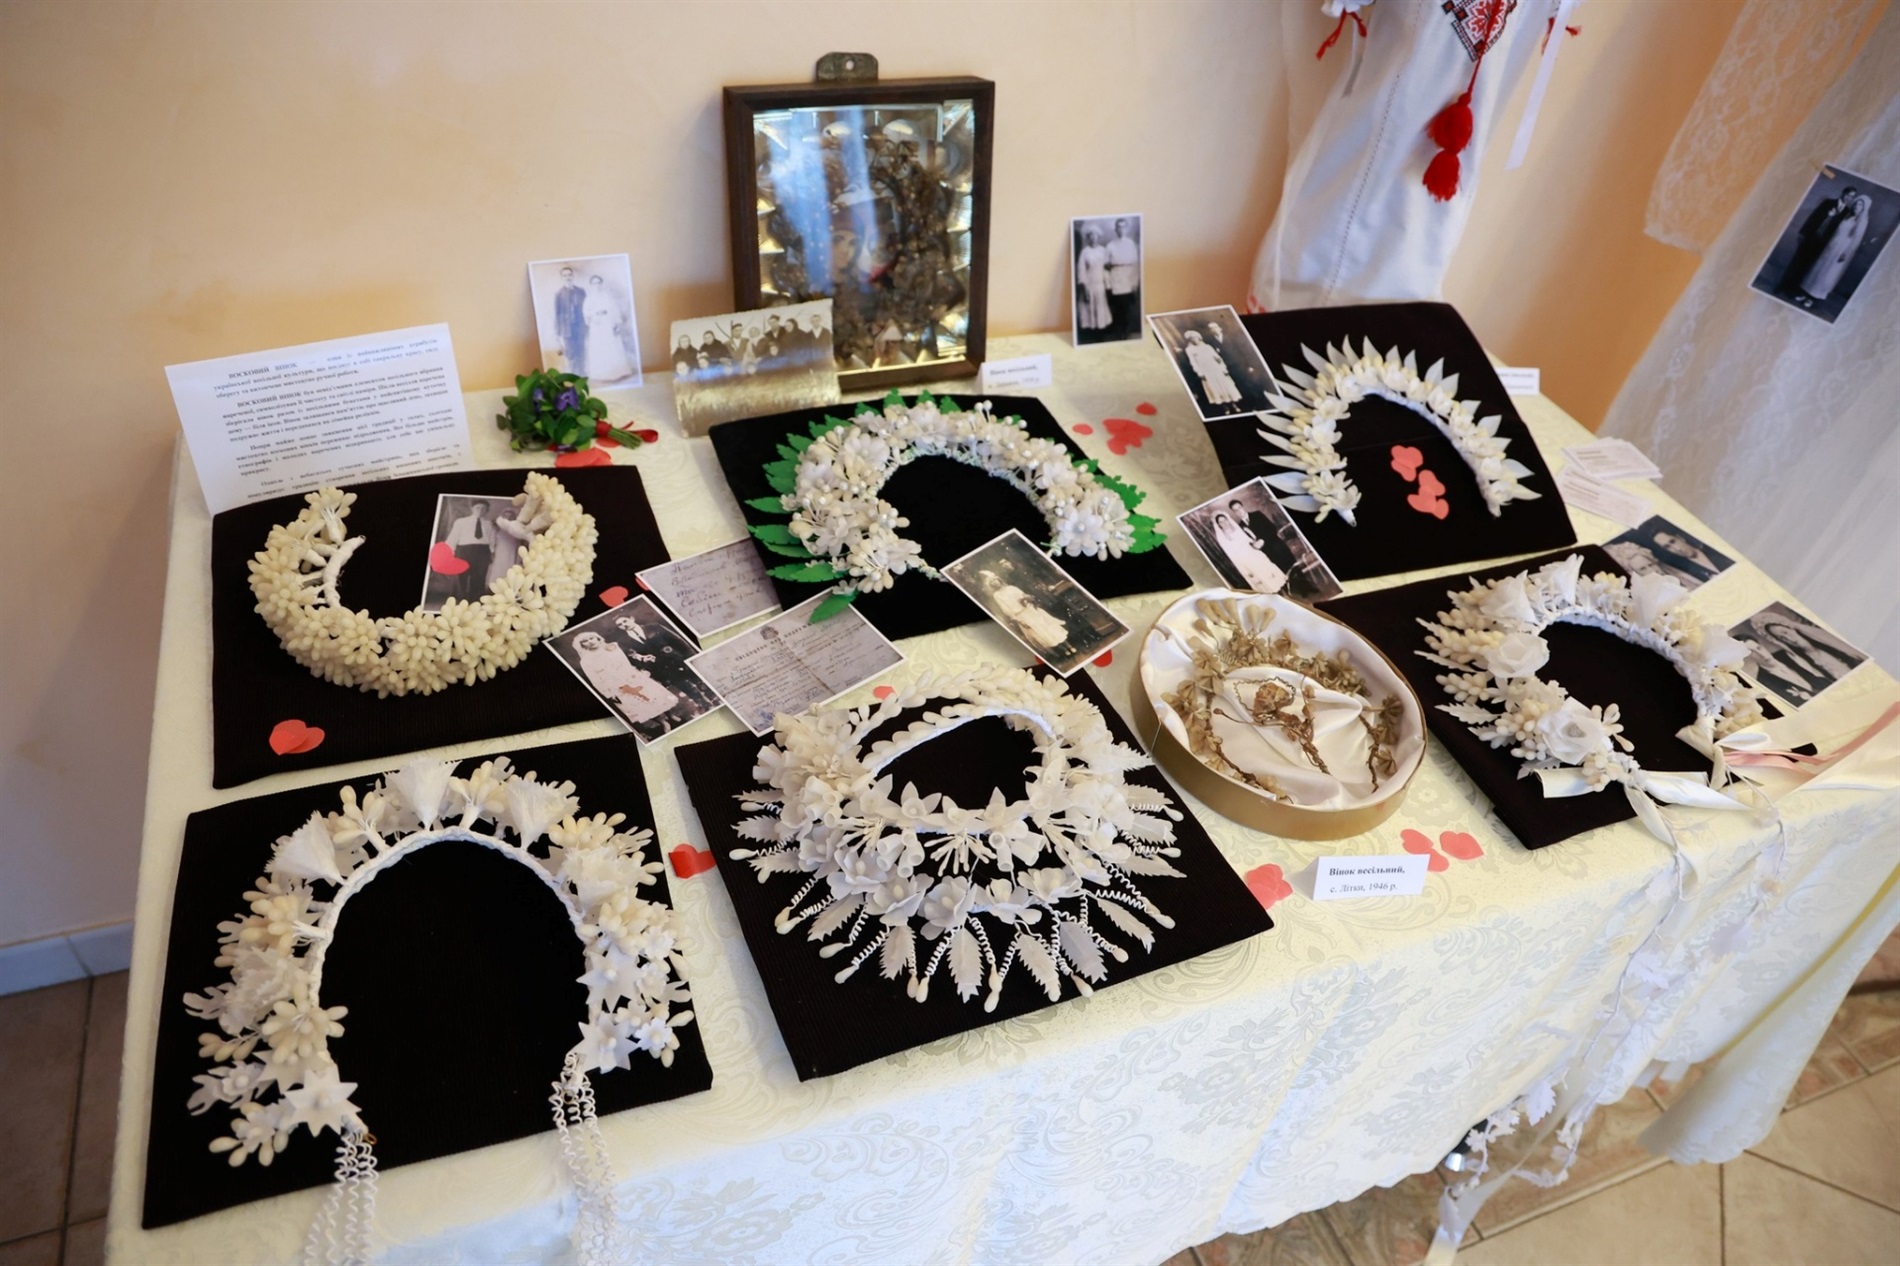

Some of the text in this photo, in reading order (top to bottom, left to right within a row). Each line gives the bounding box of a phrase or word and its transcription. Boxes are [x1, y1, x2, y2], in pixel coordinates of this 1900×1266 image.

[1329, 866, 1405, 876] Вінок весільний,
[1340, 884, 1366, 893] Літки,
[1369, 882, 1388, 891] 1946
[1390, 884, 1398, 892] р.
